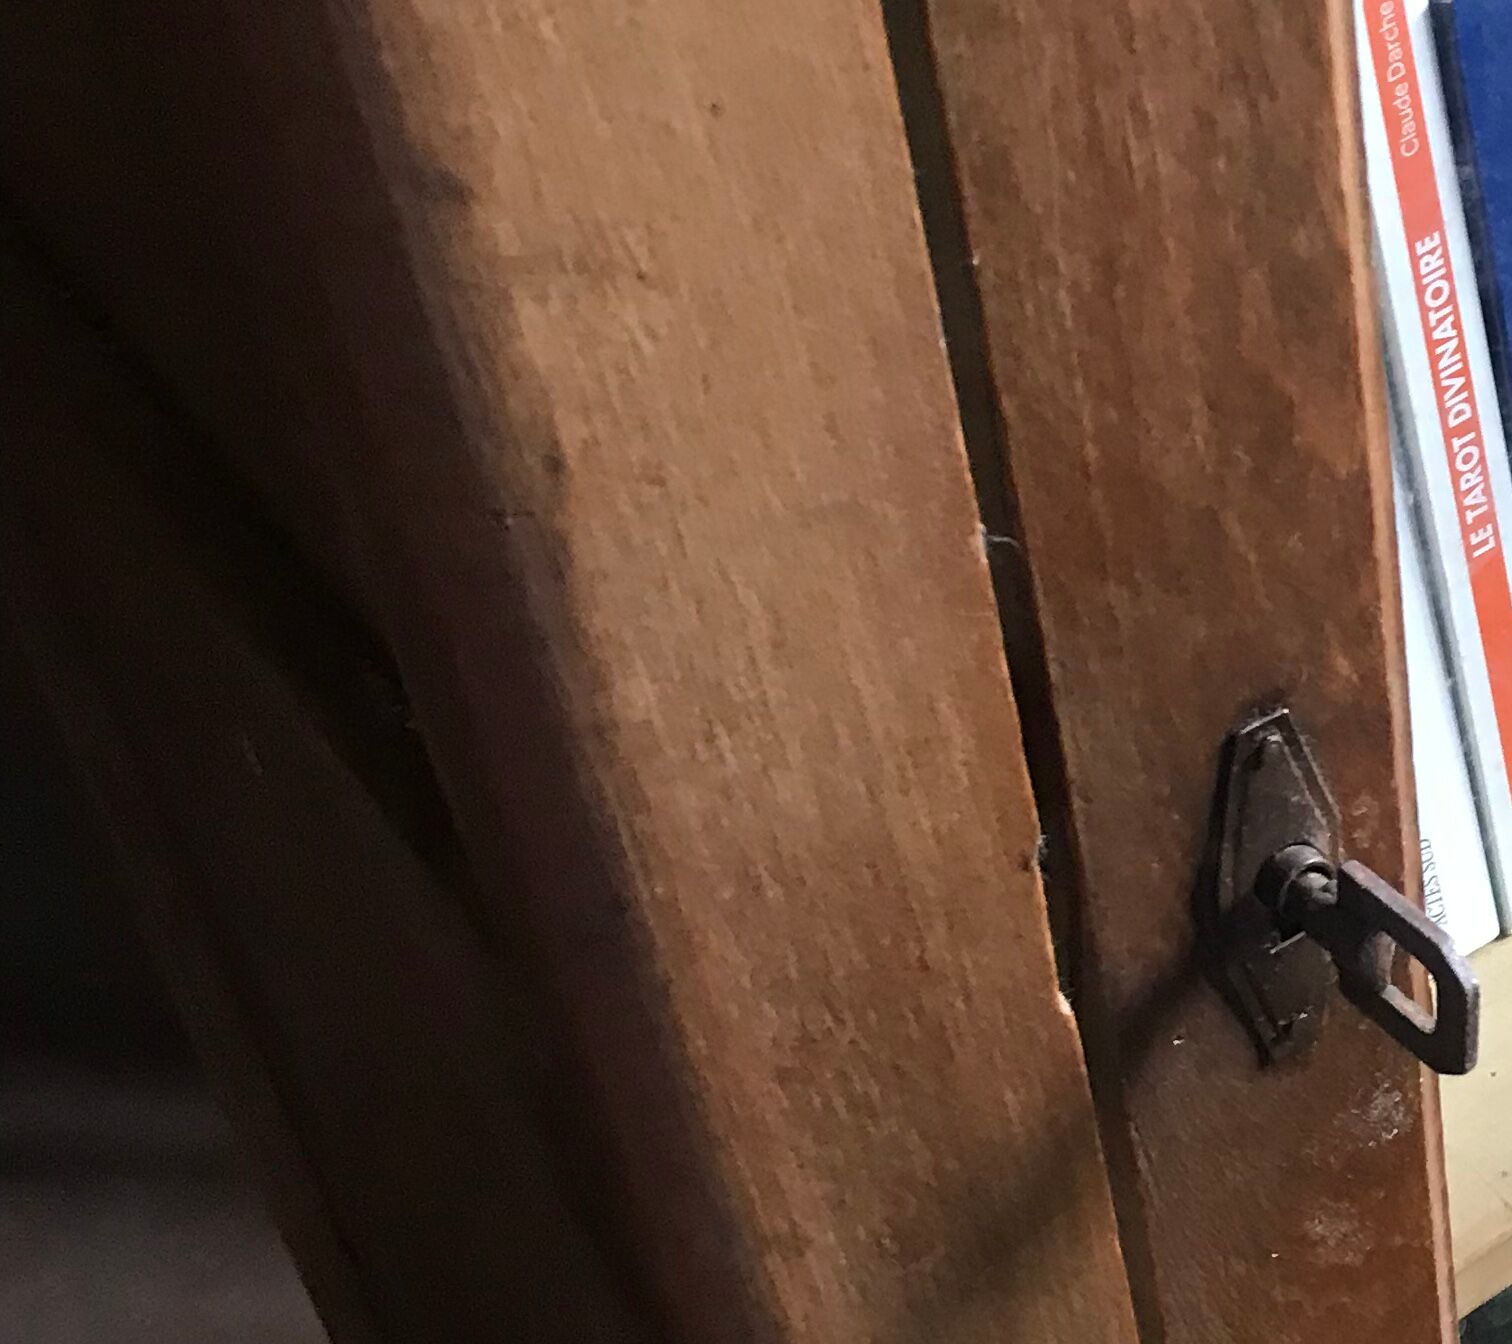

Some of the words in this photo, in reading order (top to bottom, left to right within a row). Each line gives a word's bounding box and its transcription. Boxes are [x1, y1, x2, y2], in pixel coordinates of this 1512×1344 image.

[1379, 0, 1406, 82] Darche
[1393, 82, 1419, 157] Claude
[1414, 230, 1472, 429] DIVINATOIRE
[1452, 431, 1488, 525] TAROT
[1472, 523, 1496, 558] LE
